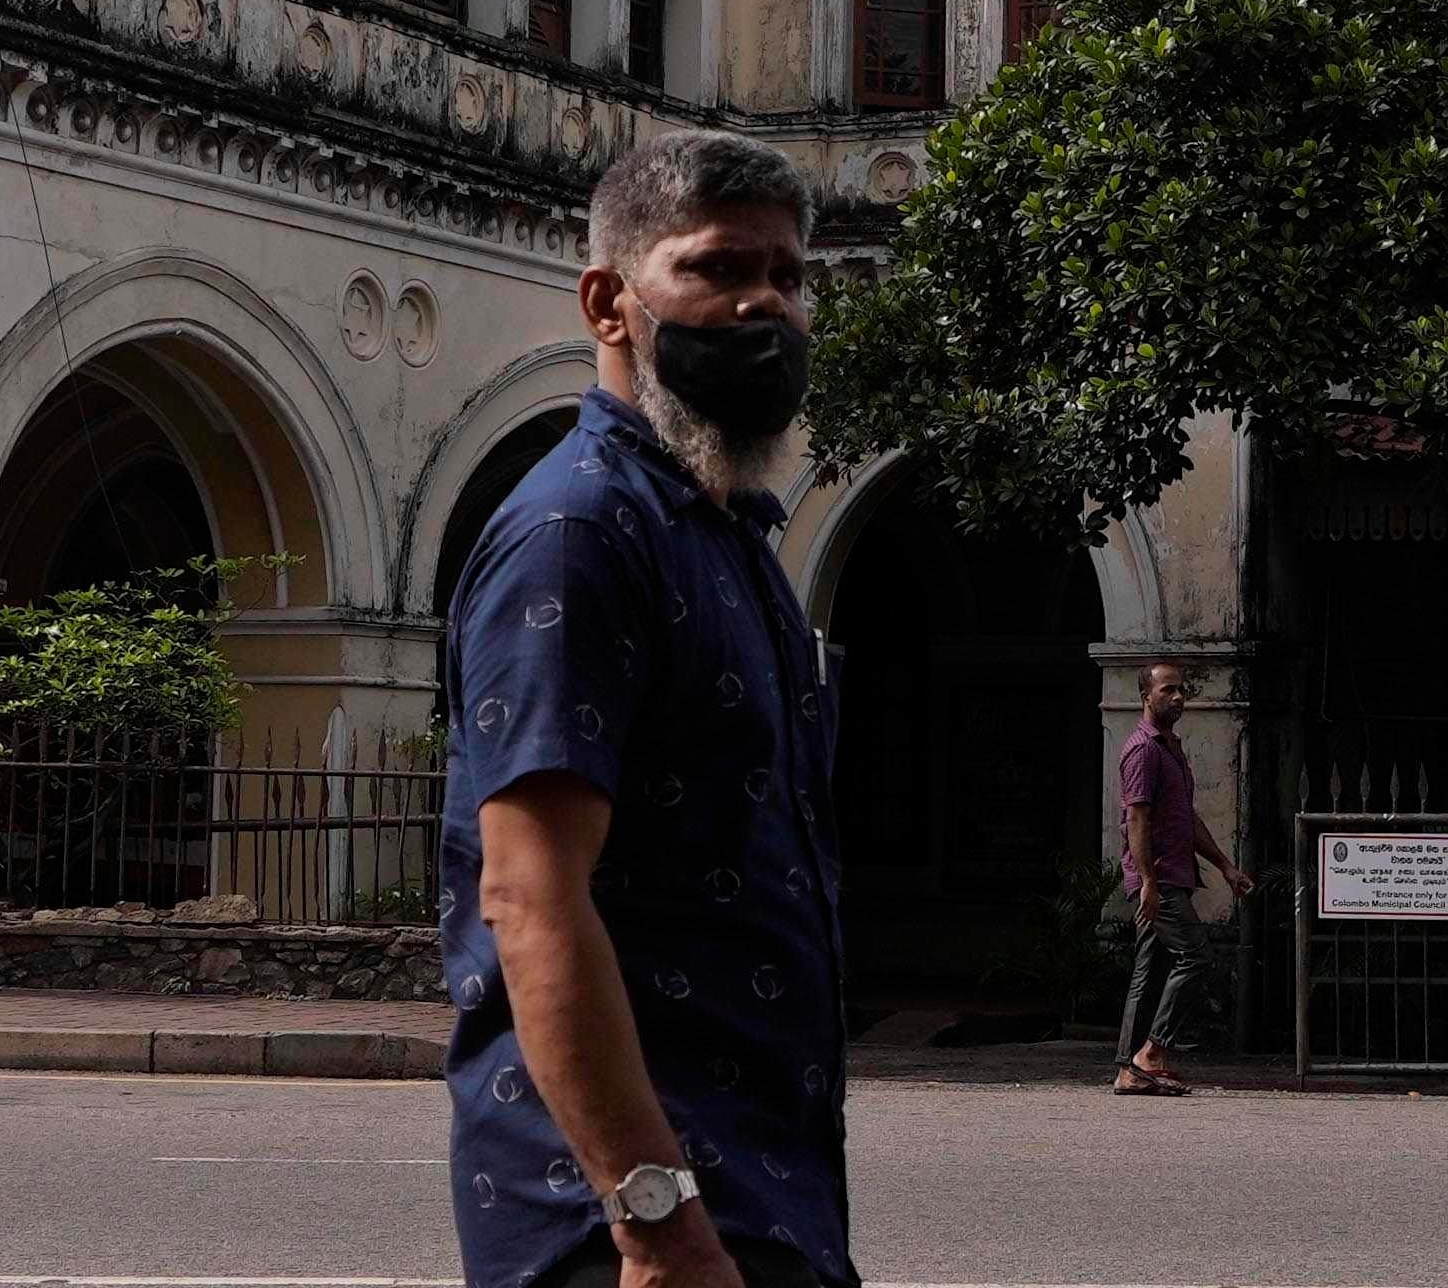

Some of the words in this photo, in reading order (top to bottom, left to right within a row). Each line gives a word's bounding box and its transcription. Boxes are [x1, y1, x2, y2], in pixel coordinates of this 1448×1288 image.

[1415, 890, 1433, 900] only
[1435, 891, 1447, 899] for
[1332, 899, 1370, 908] Colombo
[1371, 900, 1411, 909] Municipal
[1413, 900, 1446, 909] Council
